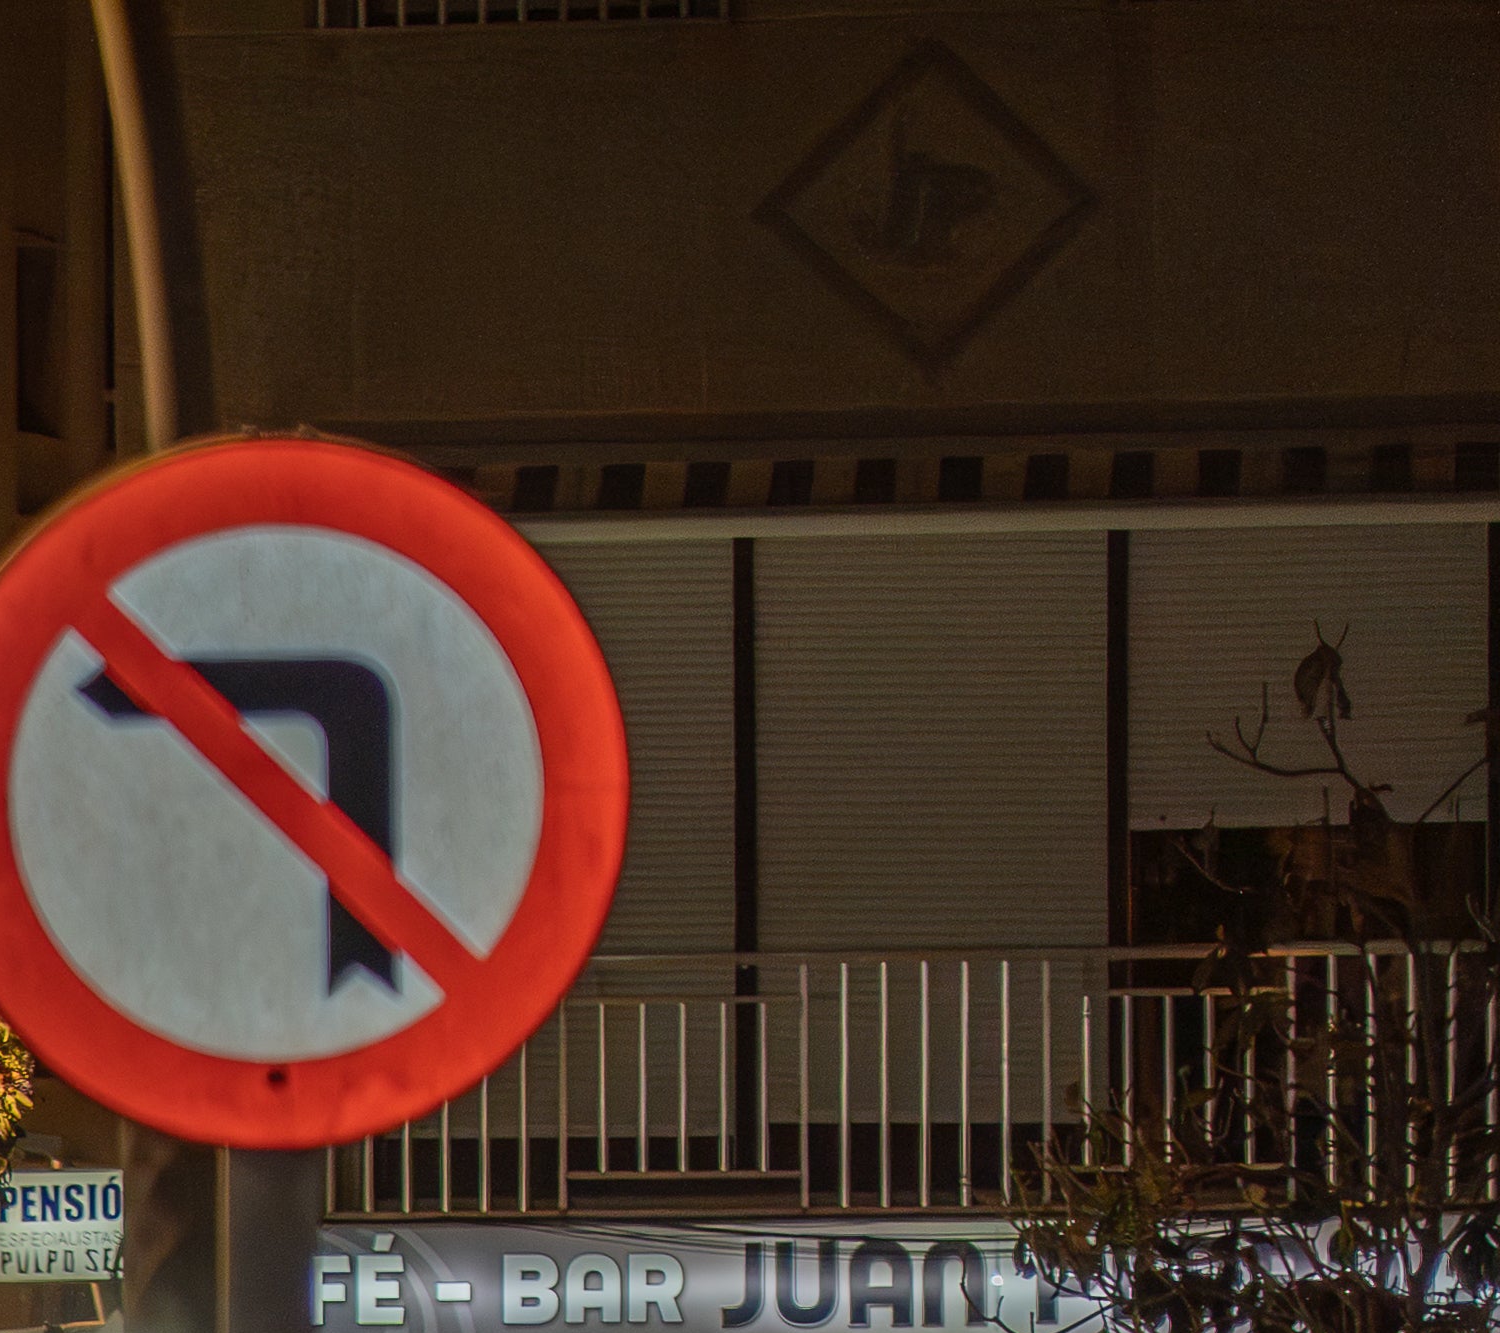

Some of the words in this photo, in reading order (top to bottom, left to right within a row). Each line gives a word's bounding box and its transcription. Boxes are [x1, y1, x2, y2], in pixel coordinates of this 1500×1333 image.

[0, 1176, 122, 1223] PENSIÓ
[0, 1230, 124, 1248] ESPECIALISTAS
[311, 1232, 405, 1327] FÉ
[503, 1253, 685, 1326] BAR
[721, 1239, 989, 1329] JUAN
